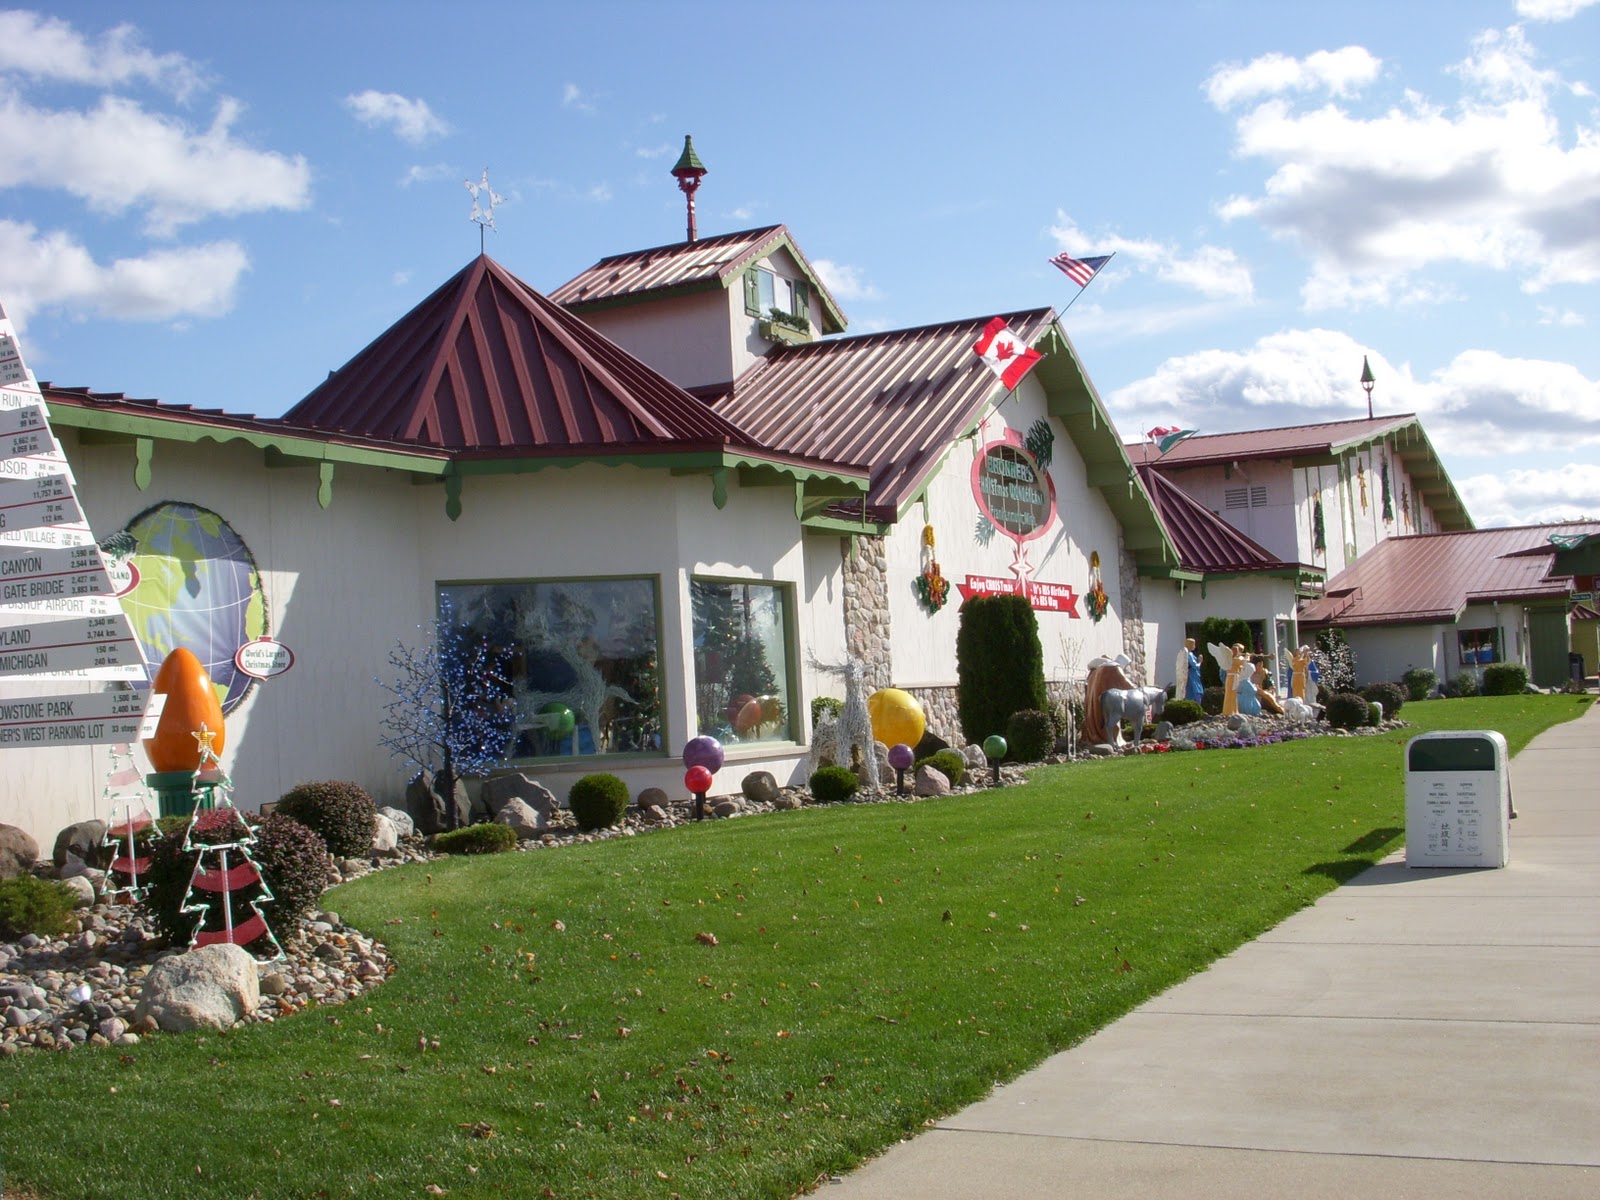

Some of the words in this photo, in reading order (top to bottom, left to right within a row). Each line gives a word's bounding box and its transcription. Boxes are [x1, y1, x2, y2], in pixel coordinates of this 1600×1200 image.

[2, 394, 21, 407] RUN
[987, 456, 1034, 482] BRONNER'S
[24, 530, 56, 543] VILLAGE
[1, 557, 42, 575] CANYON
[4, 584, 27, 599] GATE
[30, 580, 64, 596] BRIDGE
[970, 577, 985, 593] Enjoy
[46, 599, 84, 612] AIRPORT
[0, 653, 48, 671] MICHIGAN
[245, 650, 264, 658] World's
[266, 650, 285, 660] Largest
[47, 701, 74, 716] PARK
[23, 726, 46, 741] WEST
[49, 725, 85, 740] PARKING
[88, 724, 104, 738] LOT
[121, 725, 137, 733] steps
